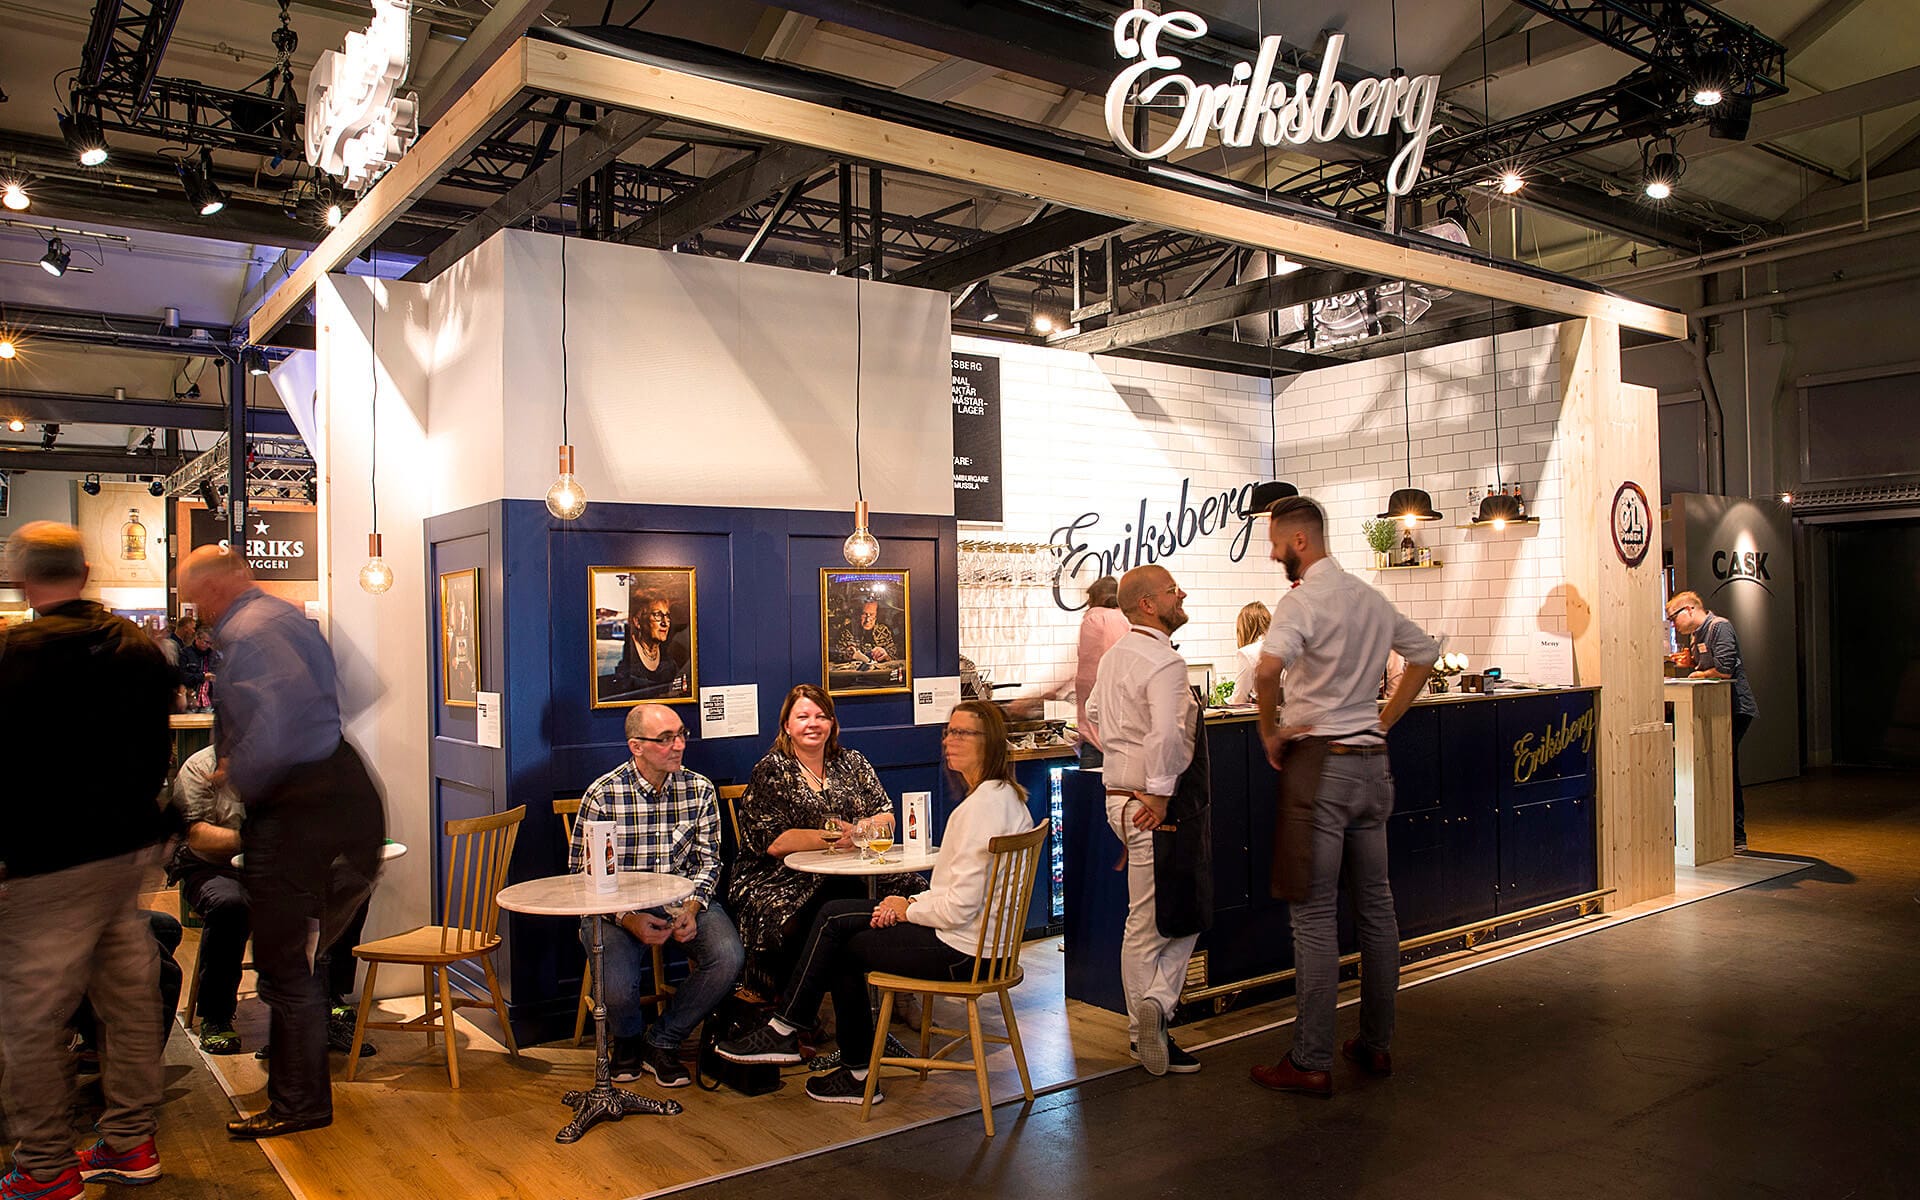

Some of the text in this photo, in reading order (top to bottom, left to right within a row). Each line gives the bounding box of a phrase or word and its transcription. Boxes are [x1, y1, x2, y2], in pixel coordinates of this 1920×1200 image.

[1105, 8, 1443, 197] Eriksberg
[952, 376, 970, 386] INAL
[952, 385, 976, 396] AKTÄR
[952, 395, 988, 406] MÄSTAR-
[957, 405, 984, 415] LAGER
[952, 457, 972, 466] ARE:
[1050, 477, 1259, 612] Eriksberg
[248, 559, 290, 569] YGGERI
[1711, 550, 1771, 581] CASK
[1540, 640, 1560, 648] Meny
[1513, 707, 1595, 783] Eriksberg
